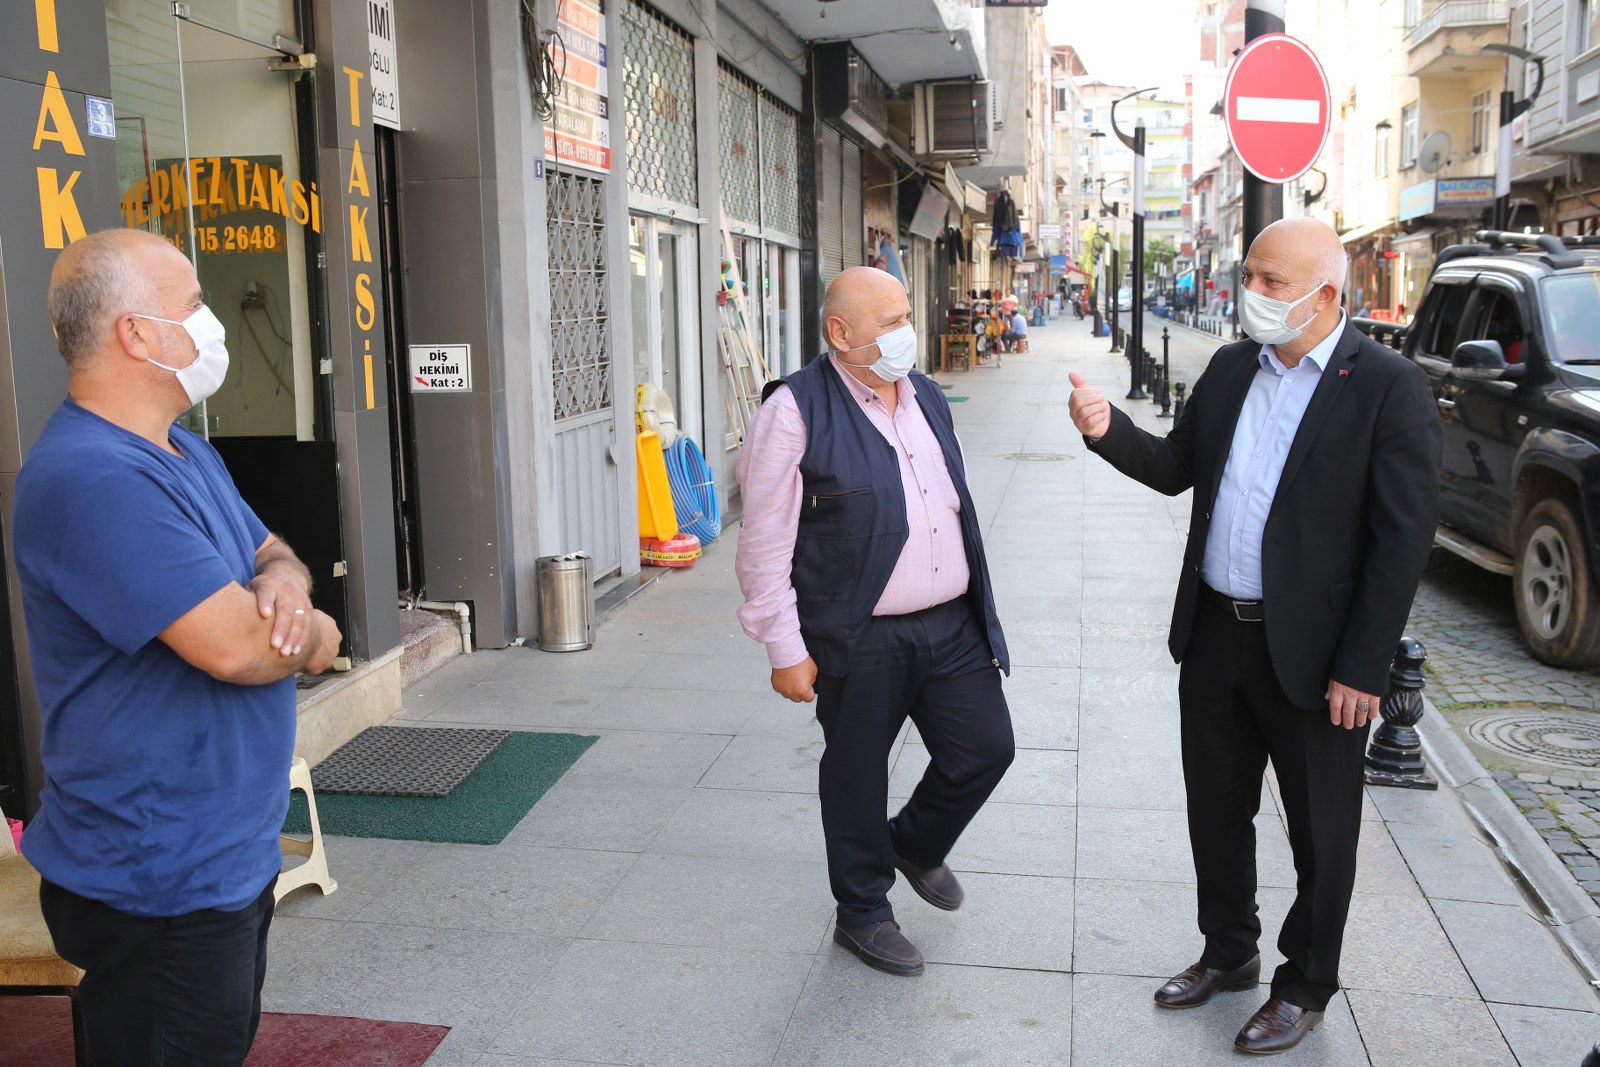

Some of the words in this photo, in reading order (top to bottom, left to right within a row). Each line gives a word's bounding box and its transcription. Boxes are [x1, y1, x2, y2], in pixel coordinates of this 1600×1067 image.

[390, 92, 395, 111] 2
[230, 157, 320, 234] TAKSİ
[223, 224, 276, 251] 2648
[343, 66, 375, 410] TAKSİ
[429, 349, 448, 362] DİŞ
[419, 363, 459, 375] HEKİMİ
[430, 378, 449, 388] Kat
[457, 378, 464, 387] 2
